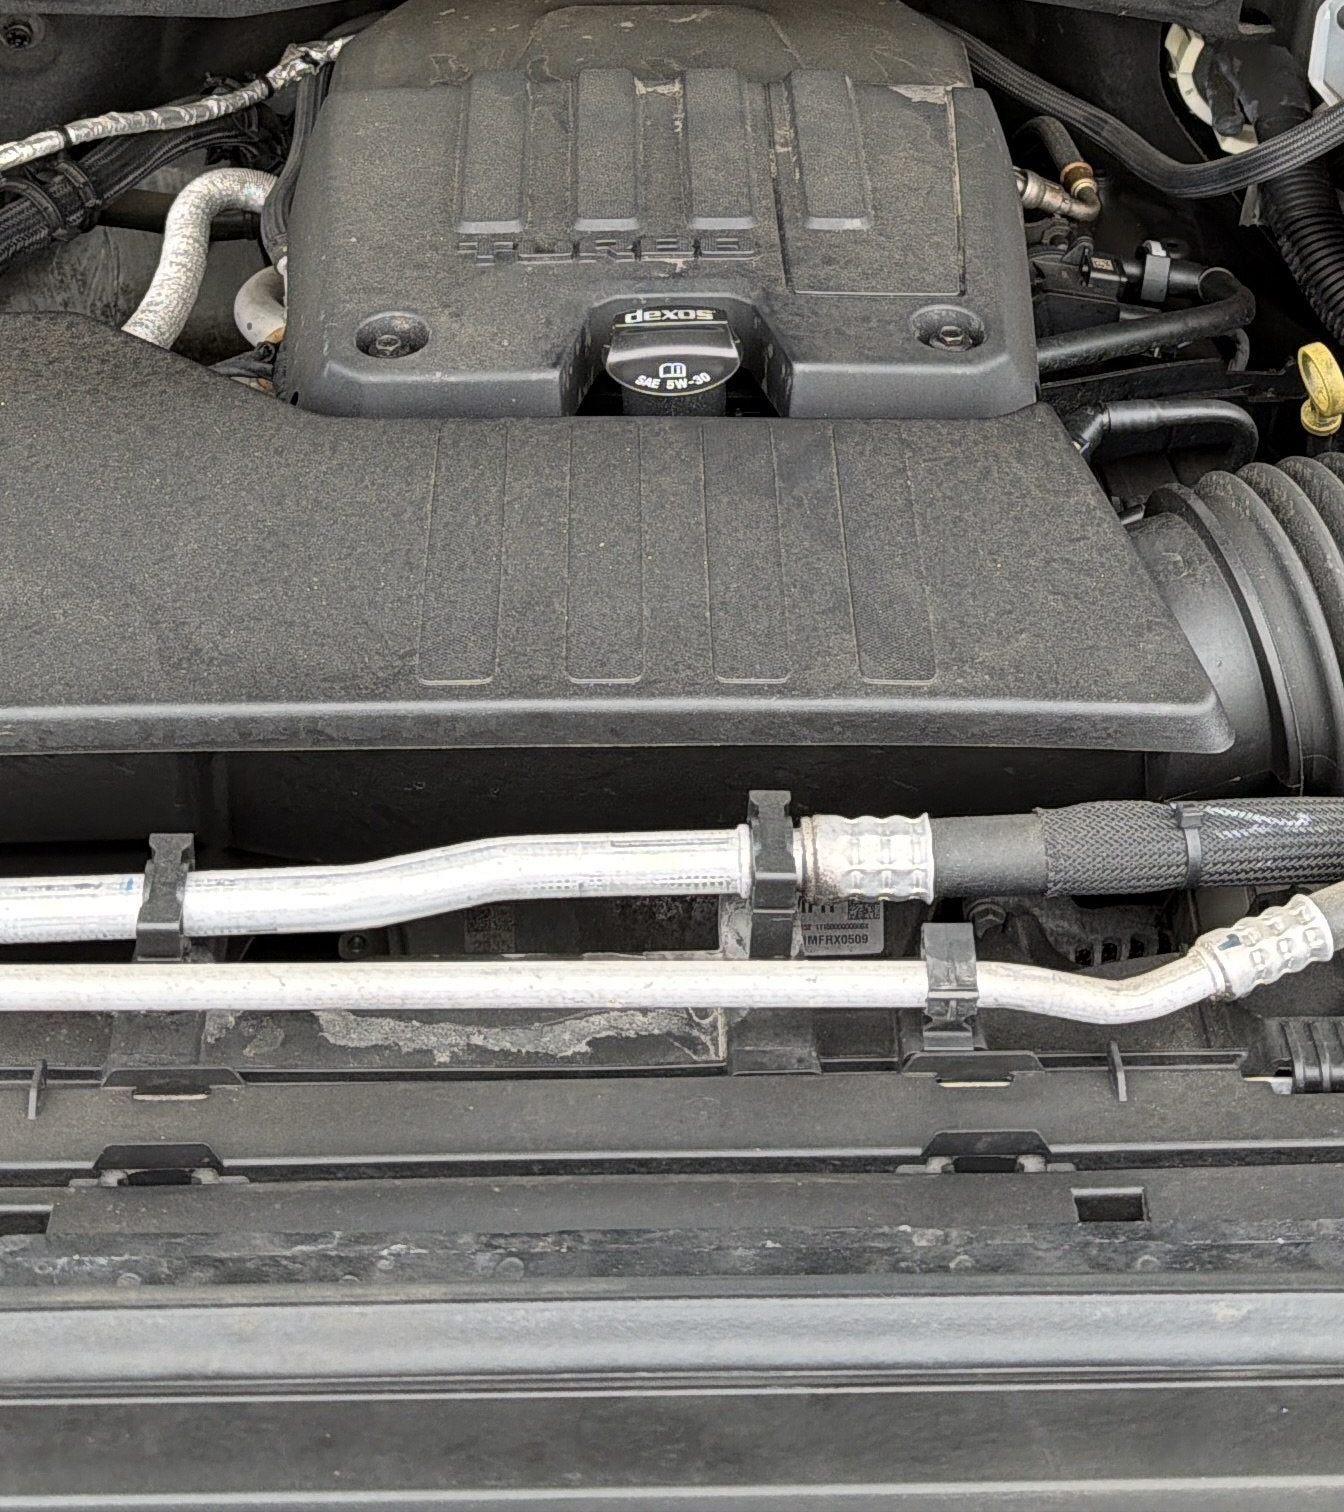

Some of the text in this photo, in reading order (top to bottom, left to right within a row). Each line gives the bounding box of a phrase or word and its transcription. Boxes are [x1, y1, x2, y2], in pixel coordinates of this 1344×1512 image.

[457, 235, 756, 266] TURBO
[624, 308, 715, 324] dexos
[634, 371, 712, 390] SAE 5W-30
